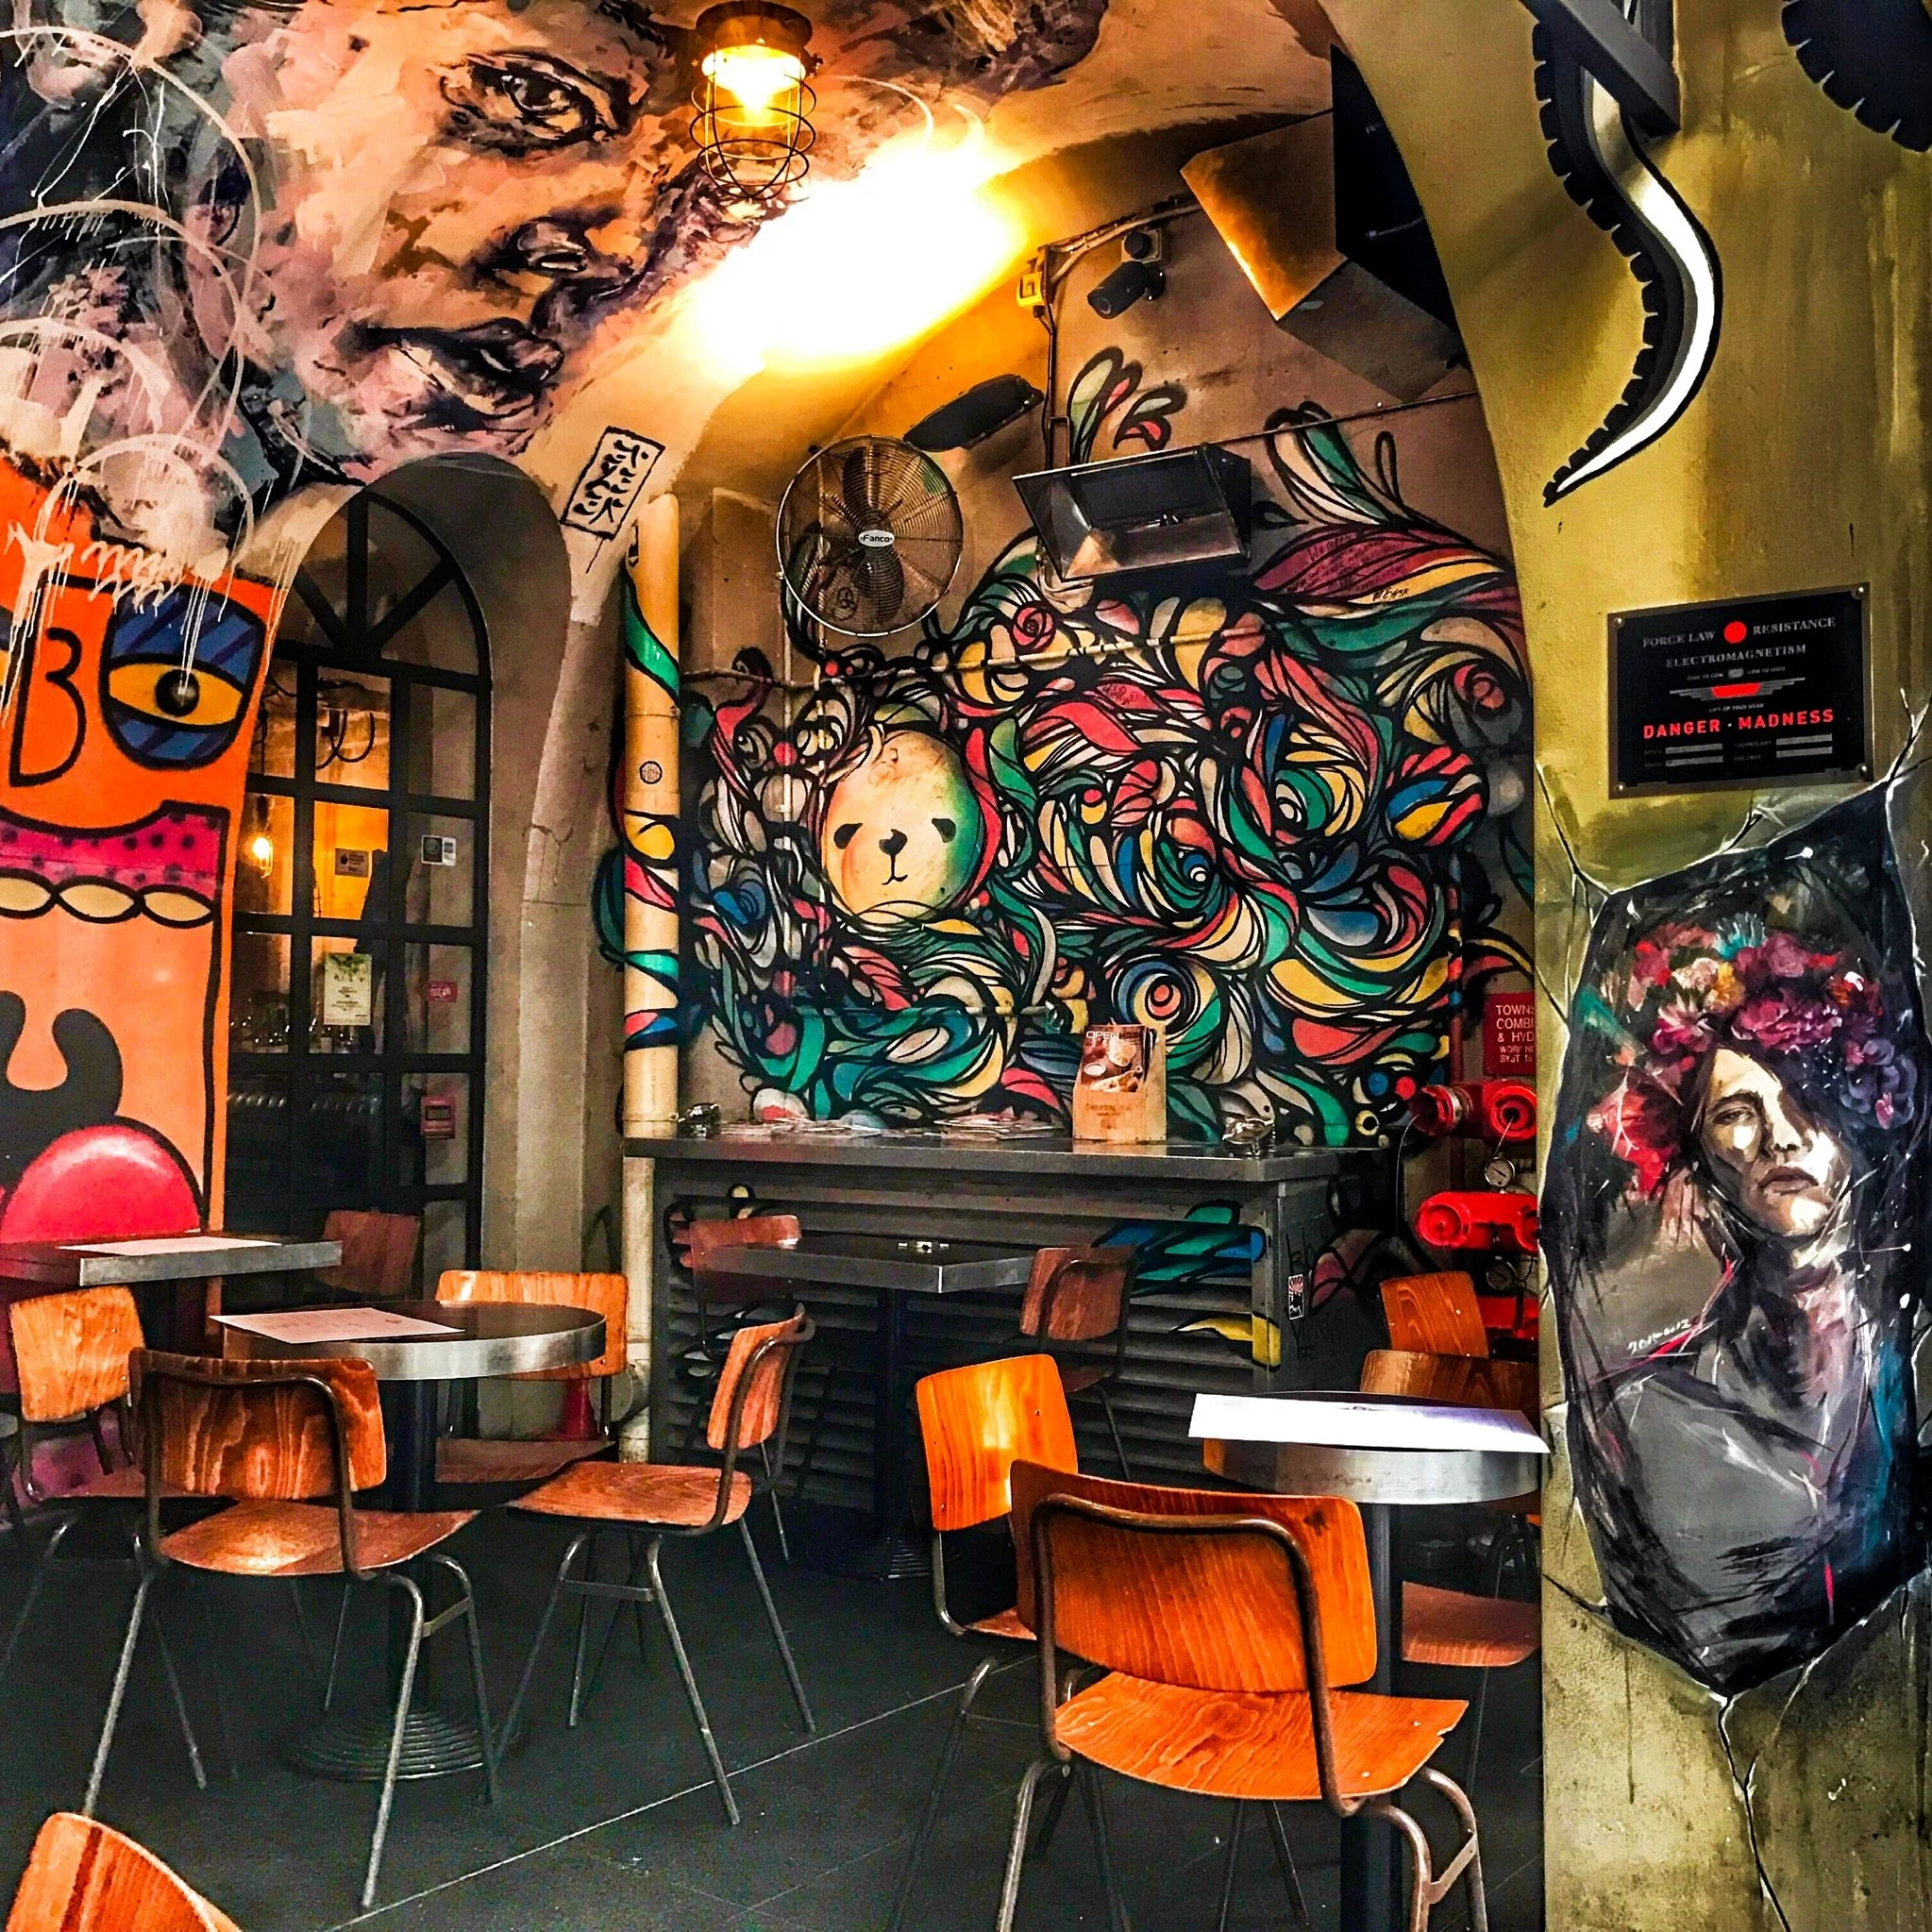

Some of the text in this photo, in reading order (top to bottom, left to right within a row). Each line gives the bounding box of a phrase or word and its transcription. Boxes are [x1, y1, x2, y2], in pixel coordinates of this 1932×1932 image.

[863, 534, 890, 543] Fanco
[1642, 616, 1836, 648] FORCE LAW RESISTANCE
[1666, 644, 1806, 668] ELECTROMAGNETISM
[1643, 709, 1834, 739] DANGER MADNESS
[1496, 1017, 1534, 1029] COMBI
[1497, 1032, 1535, 1042] & HYD
